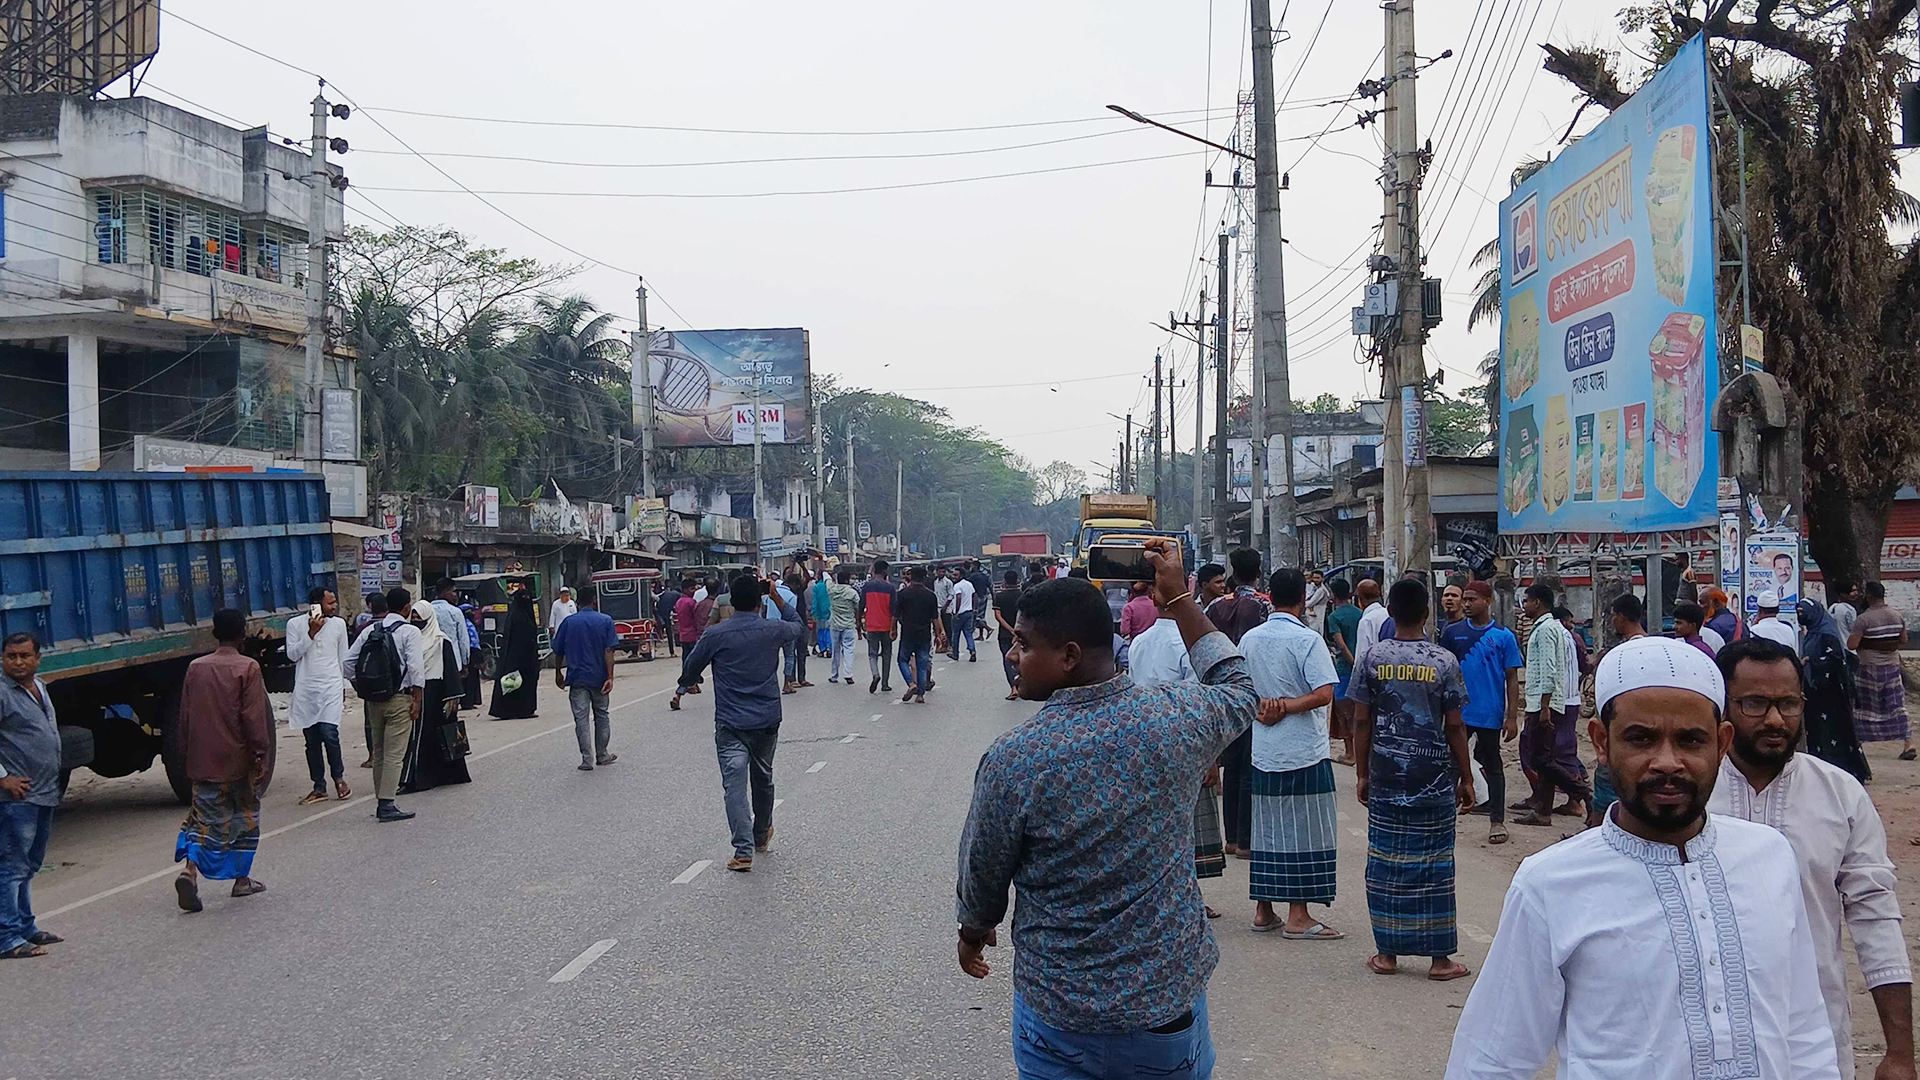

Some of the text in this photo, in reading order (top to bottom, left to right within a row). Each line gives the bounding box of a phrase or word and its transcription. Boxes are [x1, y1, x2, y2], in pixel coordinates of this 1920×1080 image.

[1377, 664, 1437, 683] DO OR DIE
